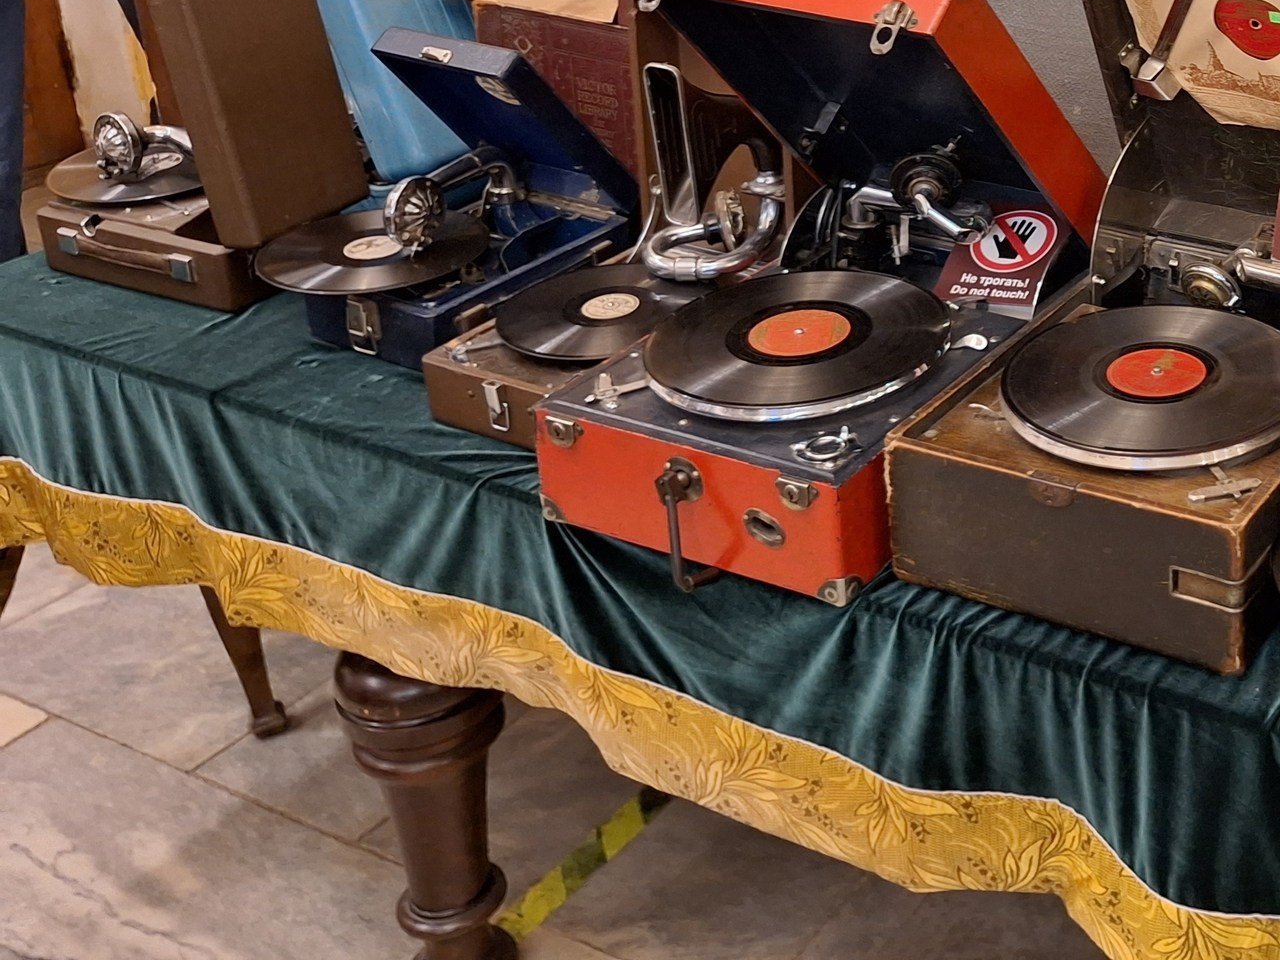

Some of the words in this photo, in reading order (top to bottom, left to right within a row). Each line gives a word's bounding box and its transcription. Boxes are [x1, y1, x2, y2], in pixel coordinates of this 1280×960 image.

[960, 272, 978, 284] Не
[980, 276, 1030, 288] трогать!
[949, 284, 968, 295] Do
[969, 287, 990, 297] not
[990, 288, 1029, 300] touch!
